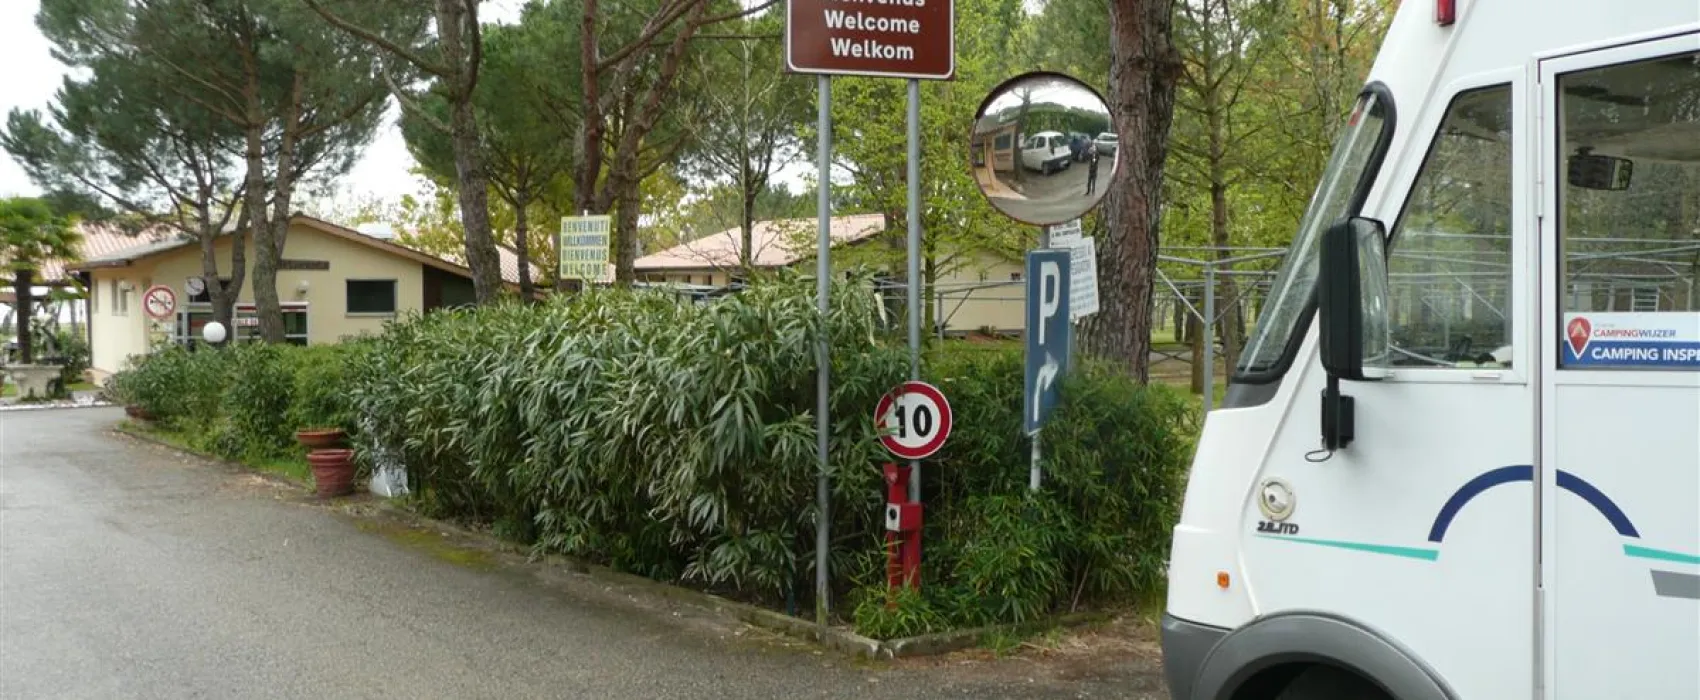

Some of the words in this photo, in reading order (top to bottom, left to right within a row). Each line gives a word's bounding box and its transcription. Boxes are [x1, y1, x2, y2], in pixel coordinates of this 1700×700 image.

[824, 9, 920, 34] Welcome
[830, 37, 913, 60] Welkom
[563, 220, 608, 233] BENVENUTI
[562, 263, 607, 276] WELCOME
[1039, 260, 1060, 345] P
[1594, 329, 1676, 338] CAMPINGWIJZER
[1591, 346, 1659, 361] CAMPING
[895, 404, 933, 438] 10
